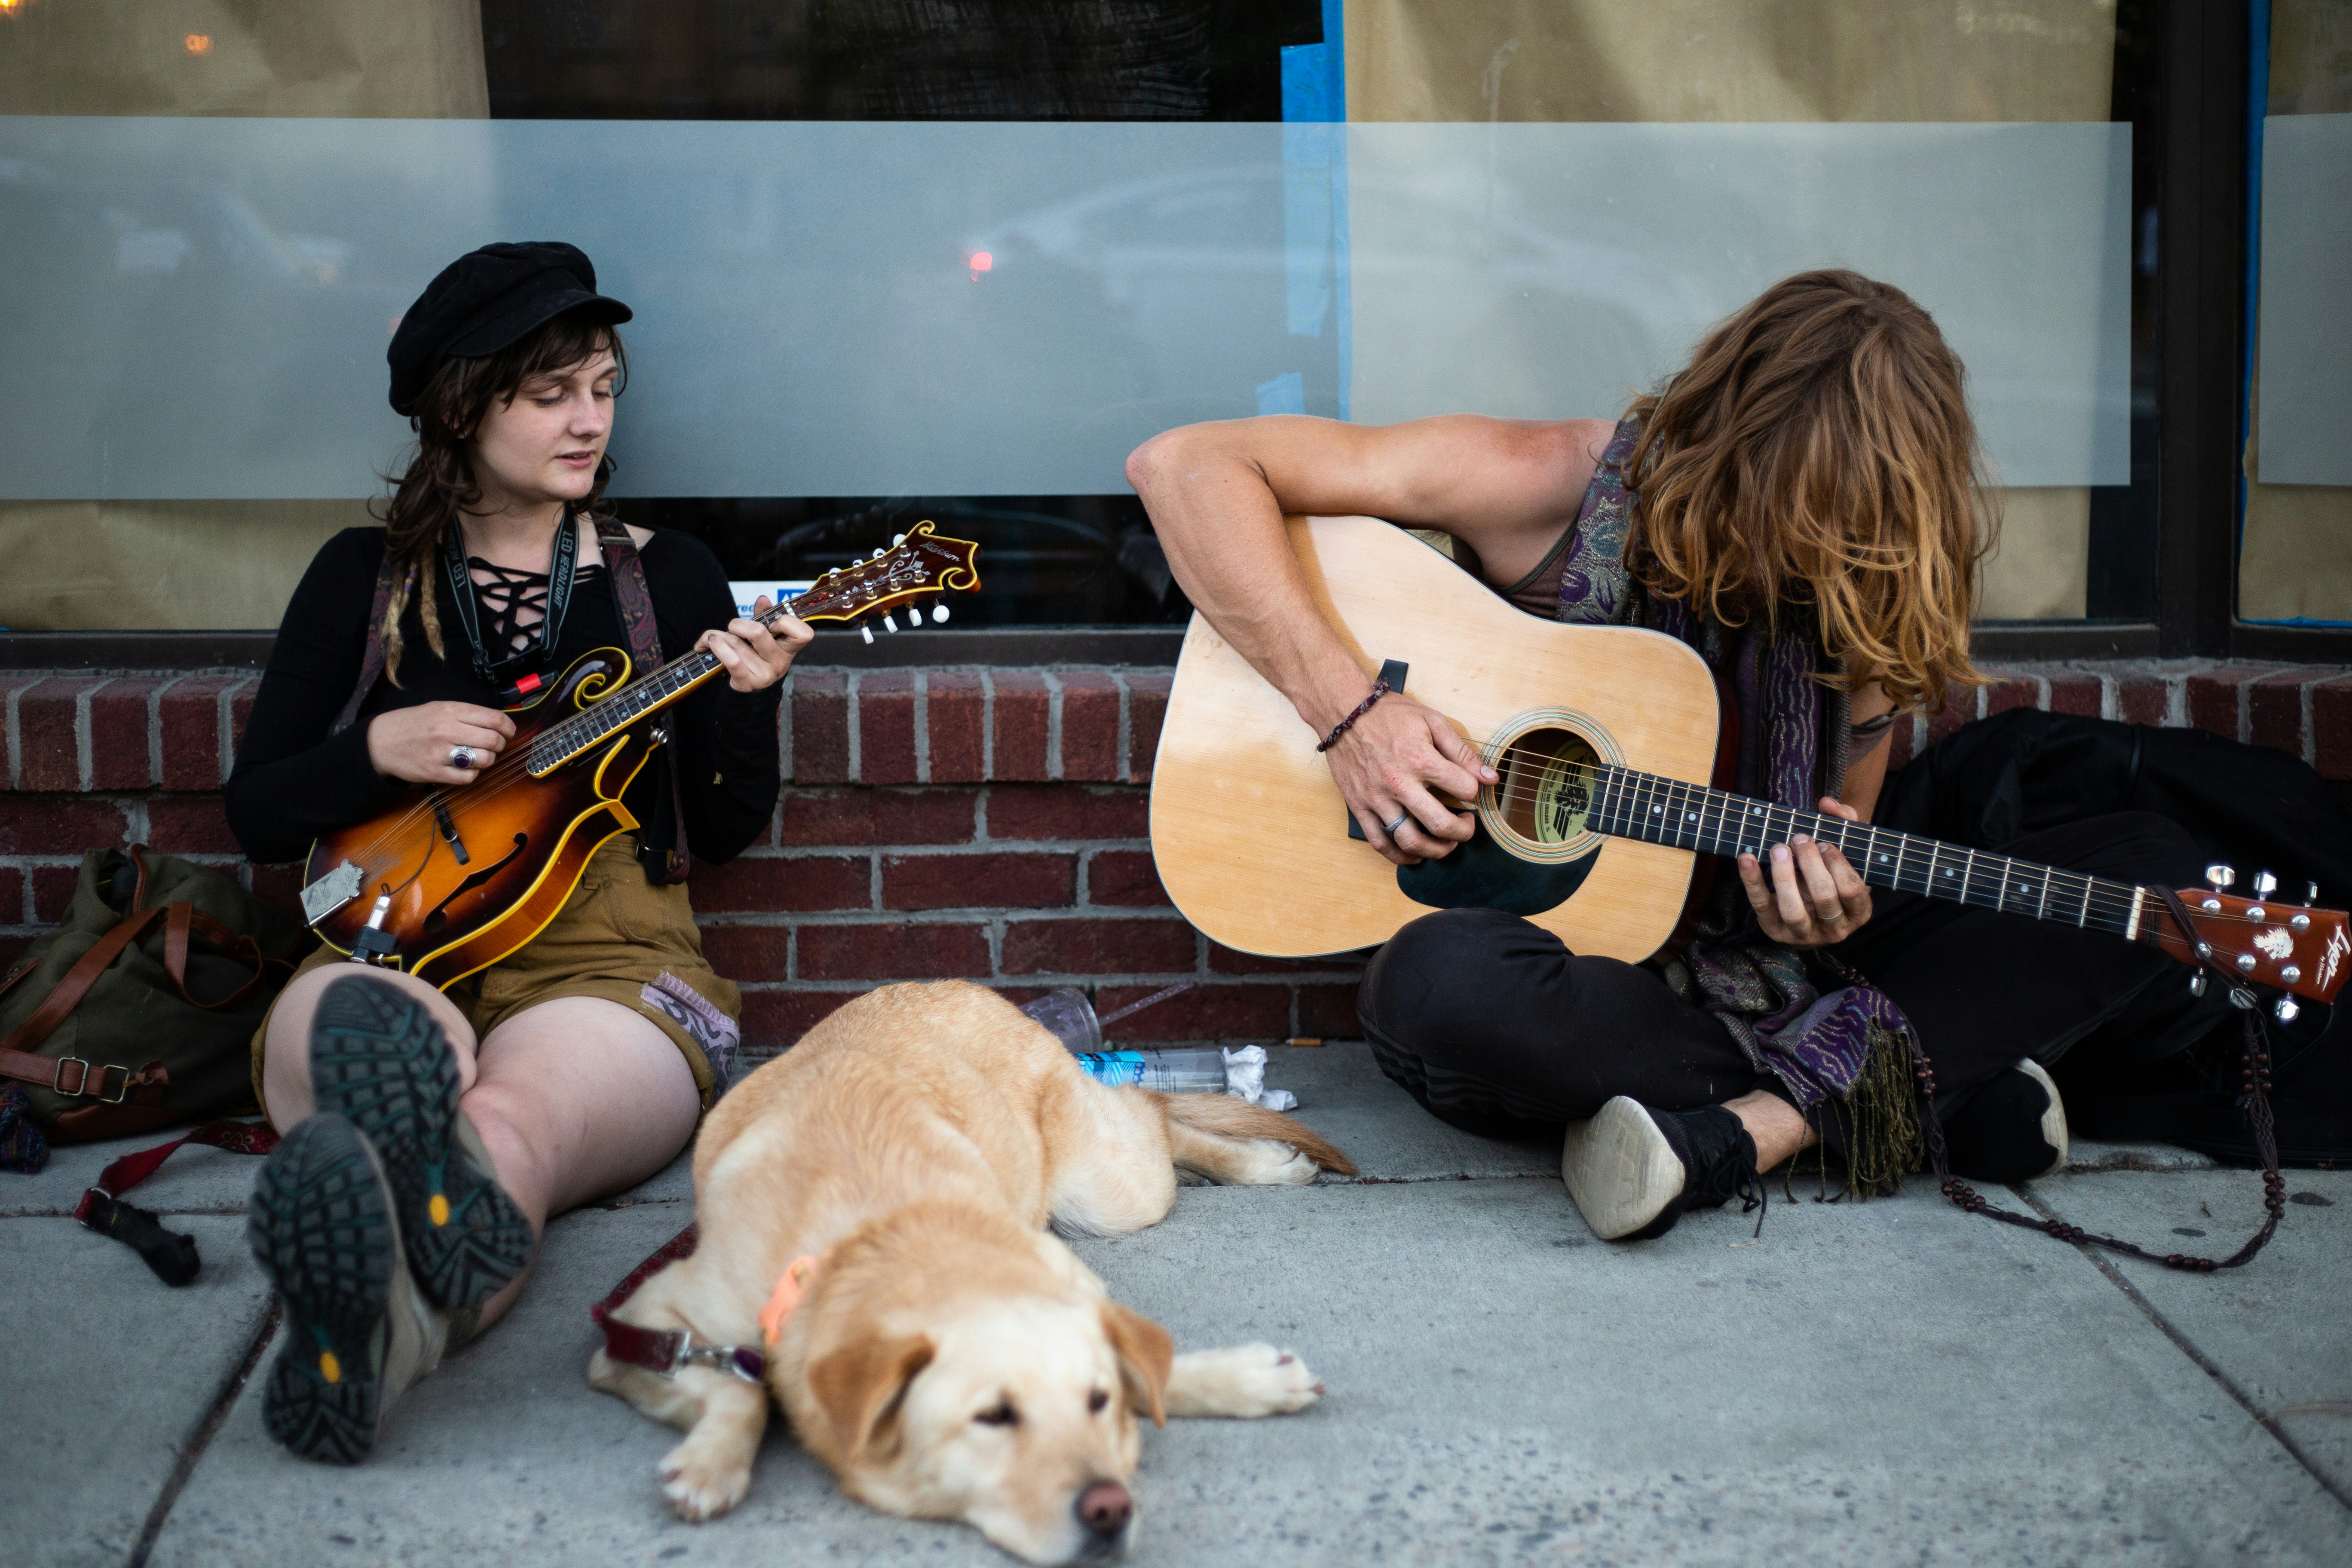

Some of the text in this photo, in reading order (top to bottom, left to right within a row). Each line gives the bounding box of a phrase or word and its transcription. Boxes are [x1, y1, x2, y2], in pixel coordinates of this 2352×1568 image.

[554, 530, 573, 609] LED HEADLIGHT
[919, 541, 961, 561] Washburn
[453, 563, 466, 588] LED
[2322, 925, 2351, 992] Lyon
